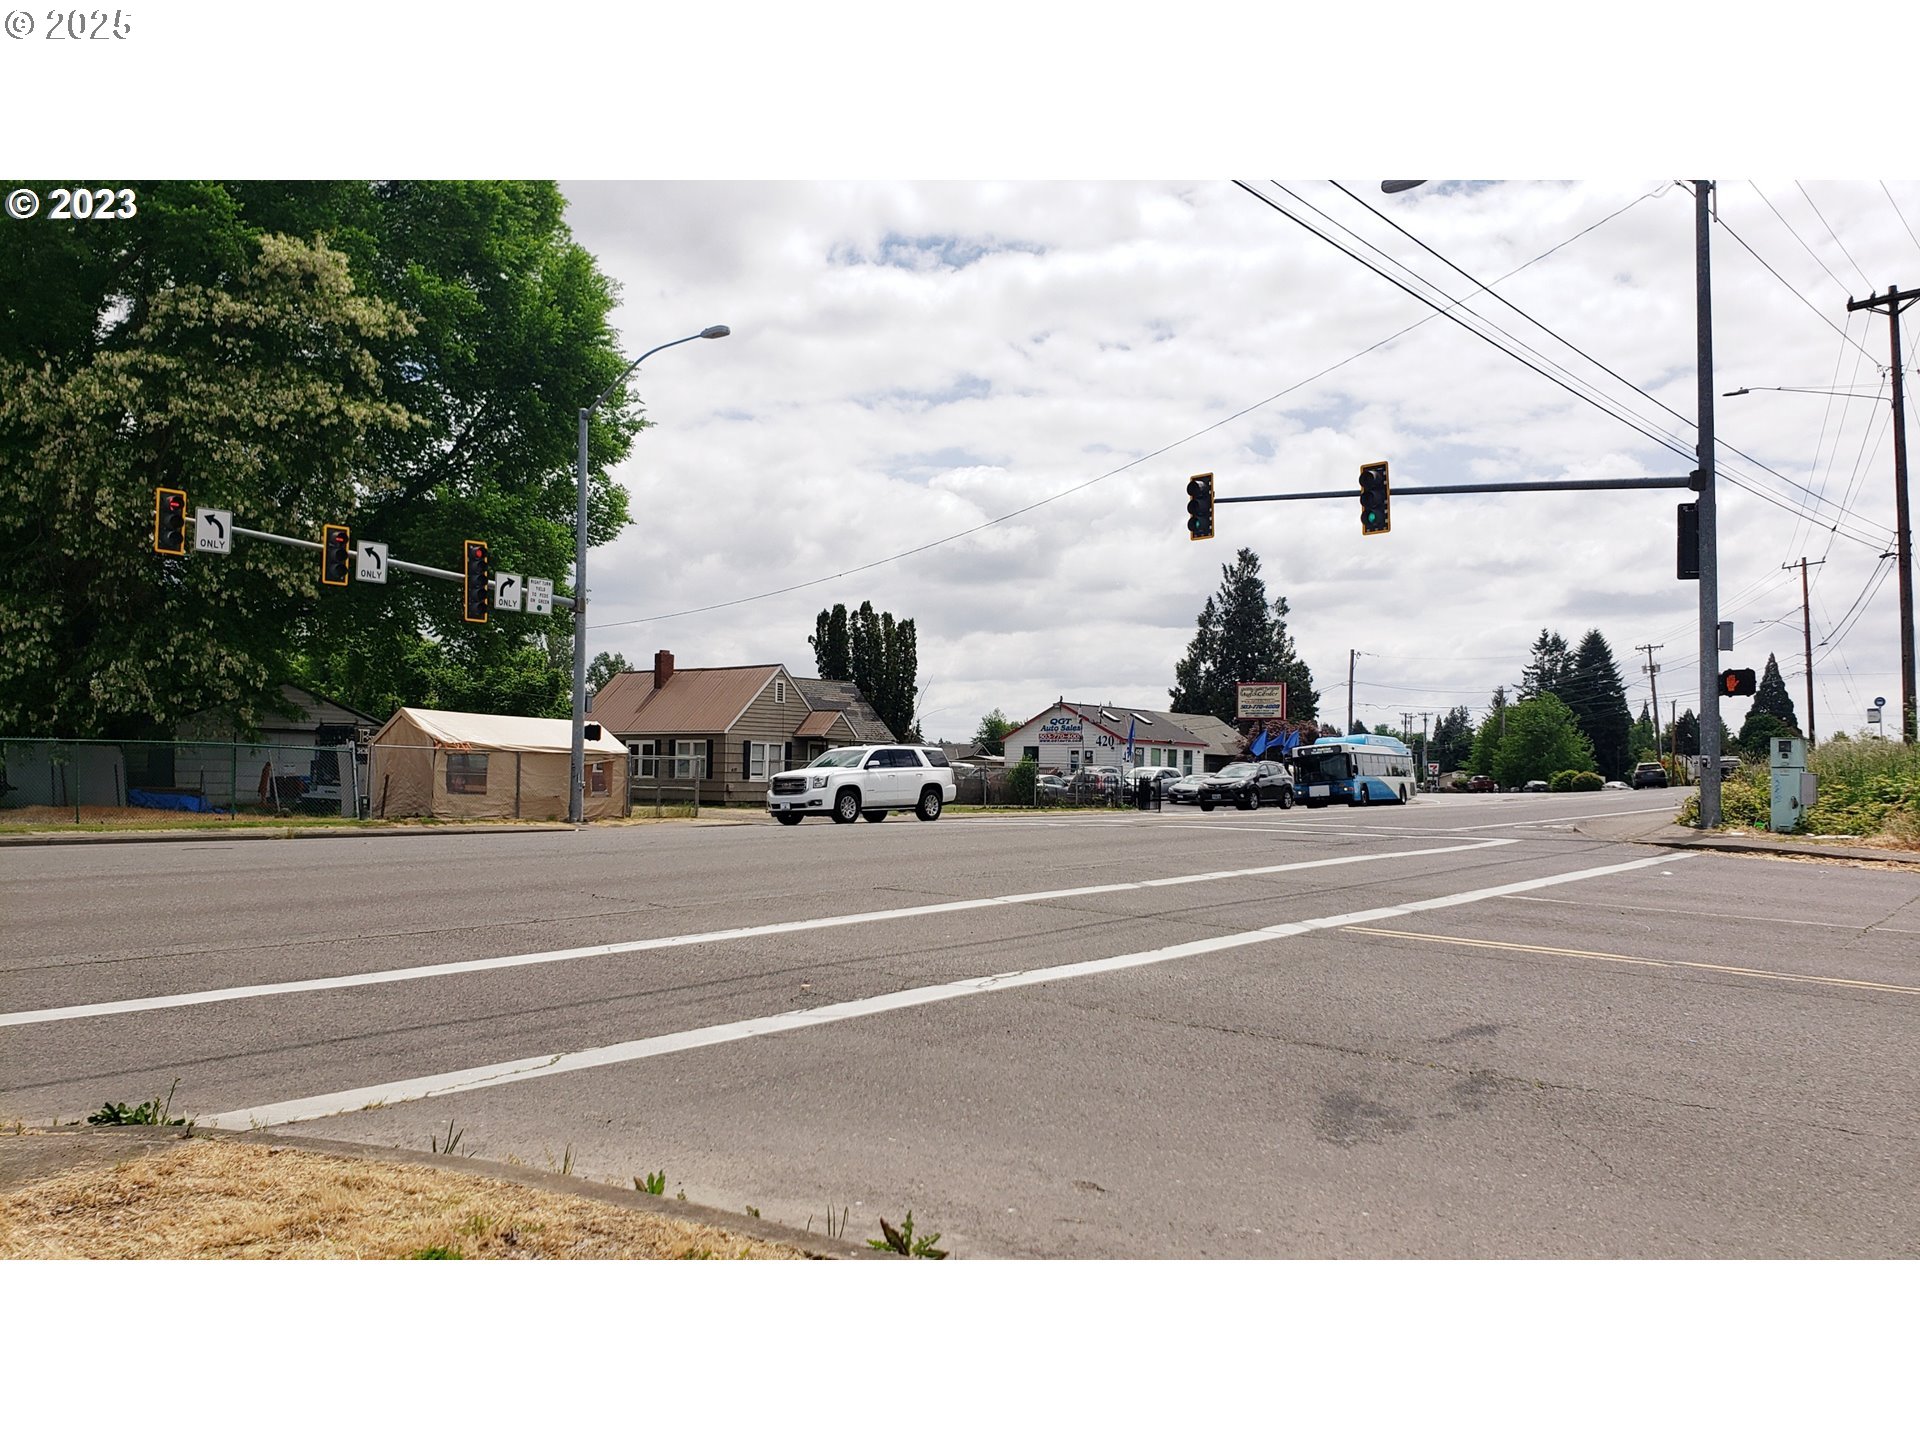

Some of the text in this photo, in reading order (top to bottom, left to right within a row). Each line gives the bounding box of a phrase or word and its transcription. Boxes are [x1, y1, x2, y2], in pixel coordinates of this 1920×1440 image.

[200, 538, 226, 549] ONLY
[361, 569, 382, 579] ONLY
[498, 598, 517, 607] ONLY
[1095, 735, 1115, 746] 420
